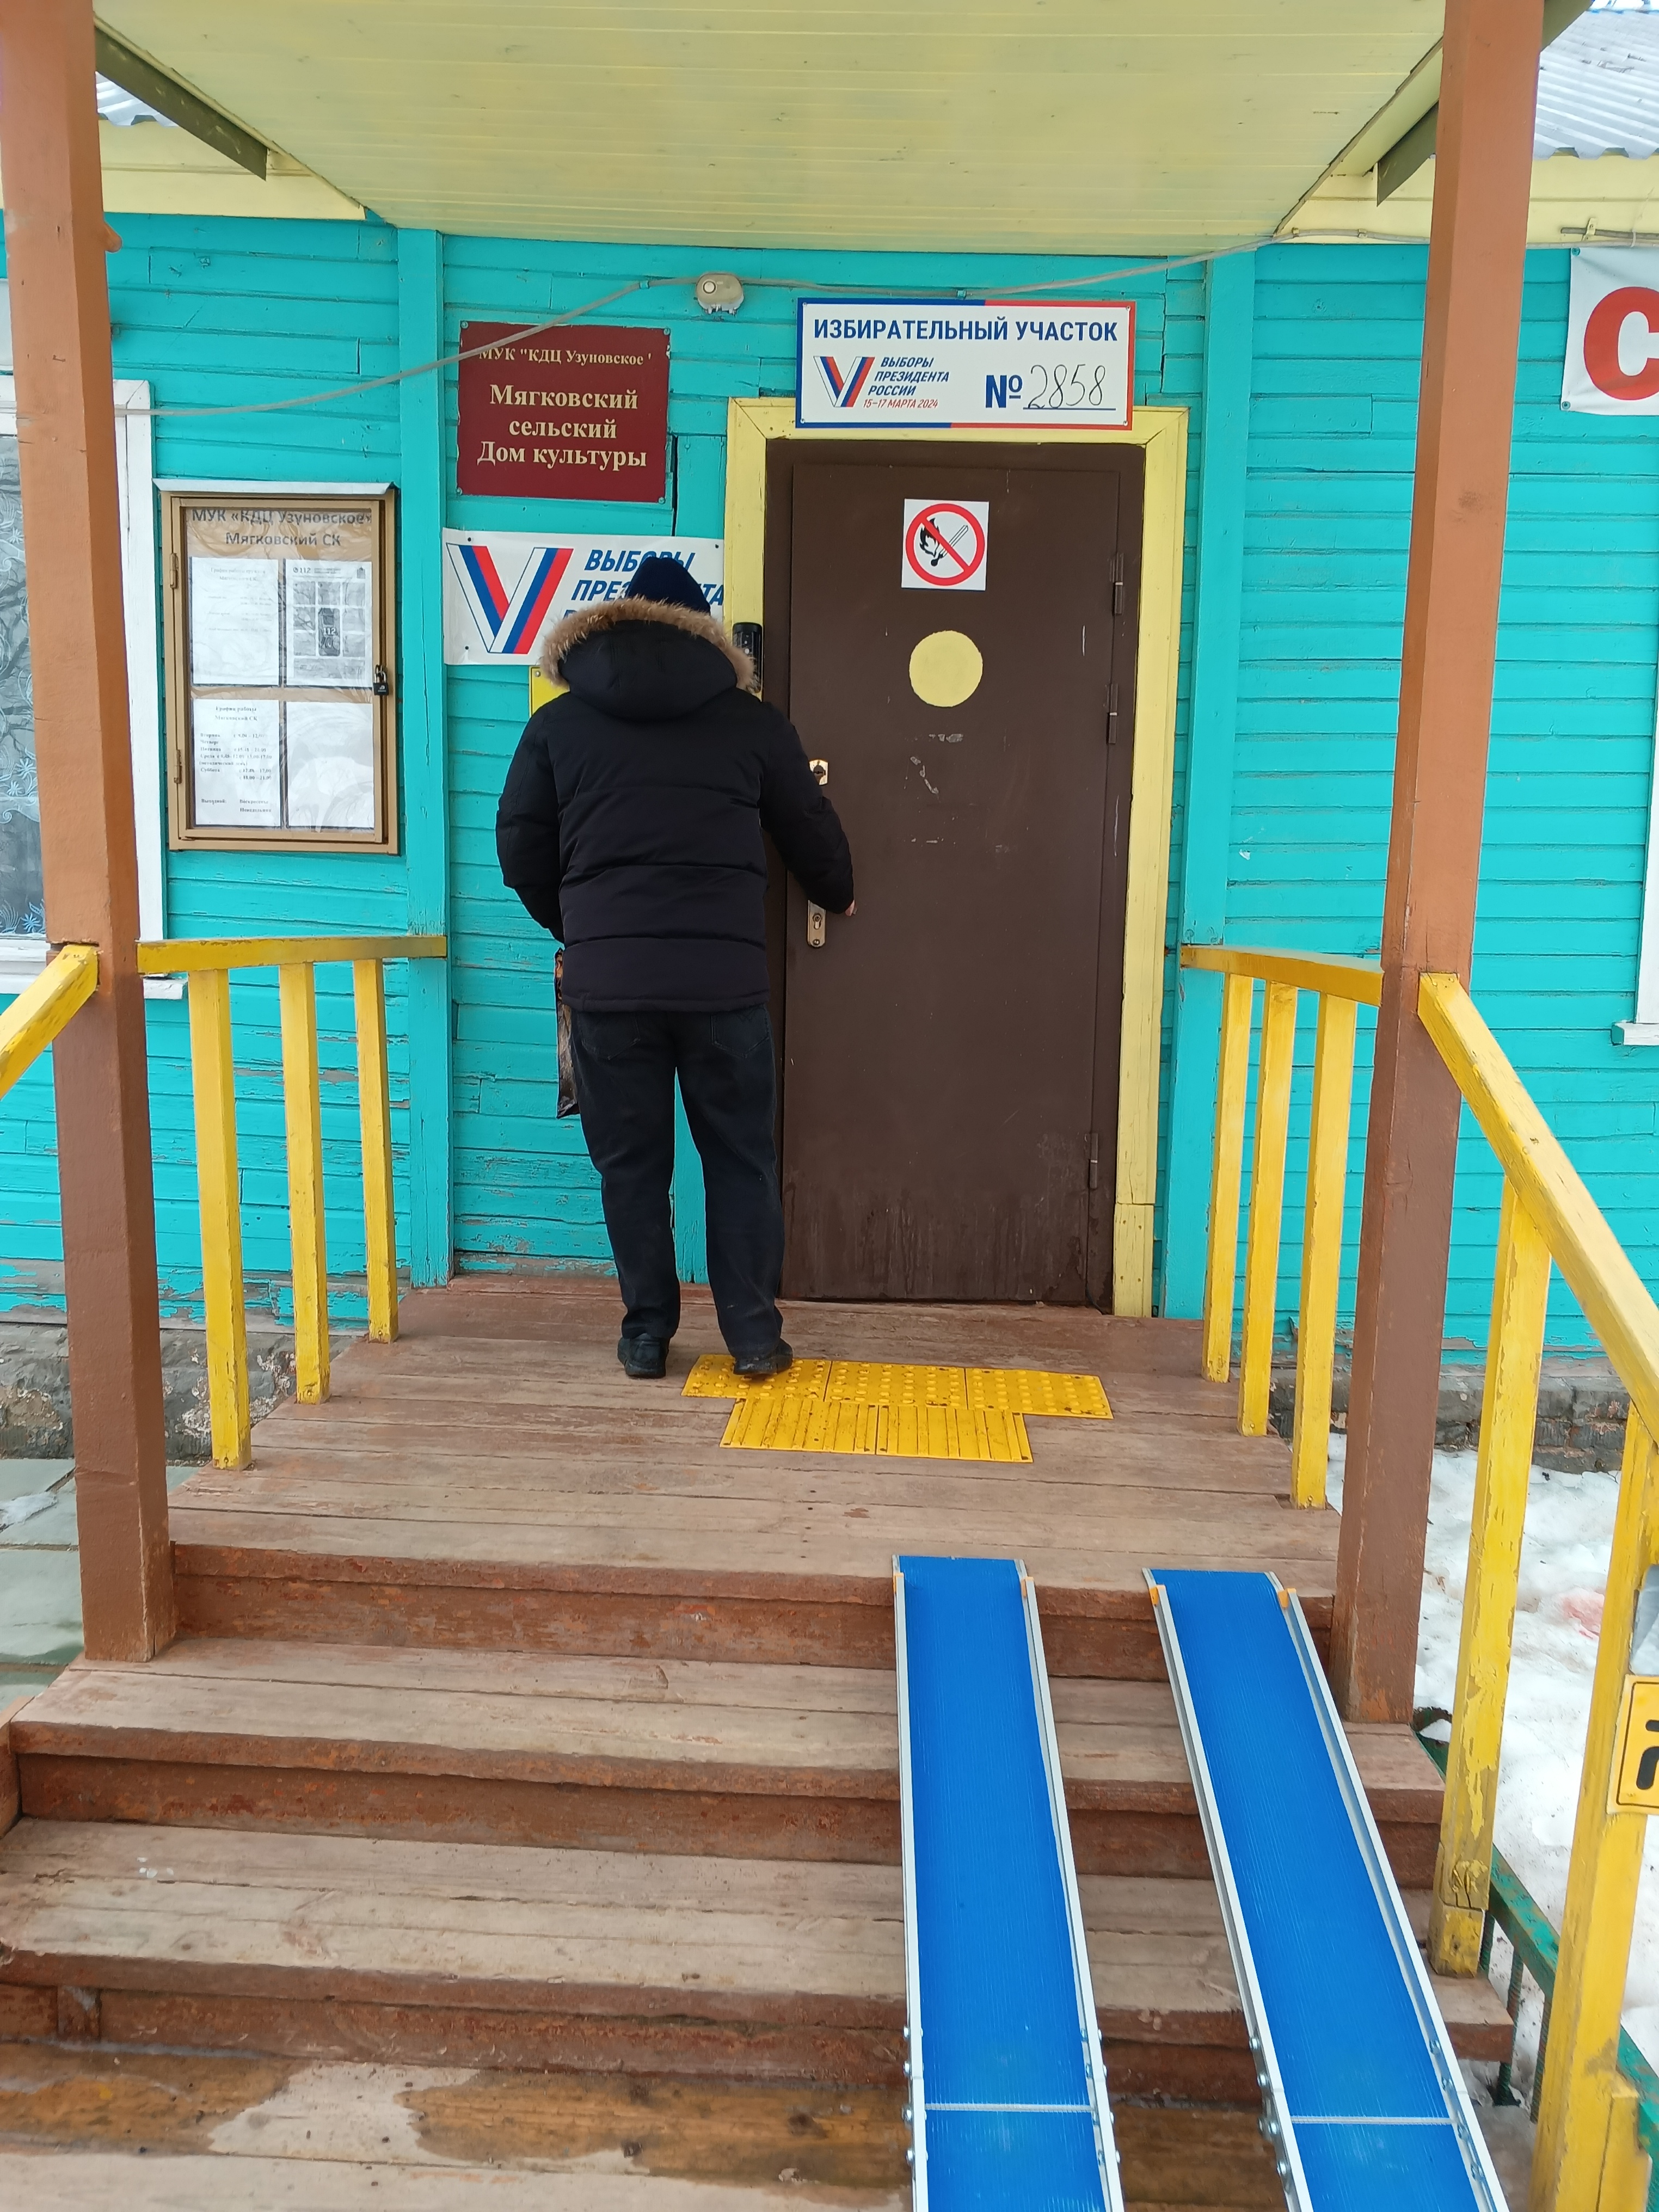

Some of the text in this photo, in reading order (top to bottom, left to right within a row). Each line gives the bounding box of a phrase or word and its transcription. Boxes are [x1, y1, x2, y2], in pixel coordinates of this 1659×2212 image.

[814, 316, 1118, 342] ИЗБИРАТЕЛЬНЫЙ УЧАСТОК
[479, 347, 516, 361] МУК
[880, 357, 935, 368] ВЫБОРЫ
[874, 371, 950, 383] ПРЕЗИДЕНТА
[868, 385, 917, 396] РОССИИ
[1027, 363, 1106, 409] 2858
[489, 384, 638, 410] Мягковский
[887, 398, 917, 409] МАРТА
[917, 398, 938, 409] 2024
[508, 418, 617, 439] сельский
[477, 441, 647, 472] Дом культуры
[192, 509, 226, 522] МУК
[226, 532, 341, 546] Мягковский СК
[323, 627, 336, 635] 112
